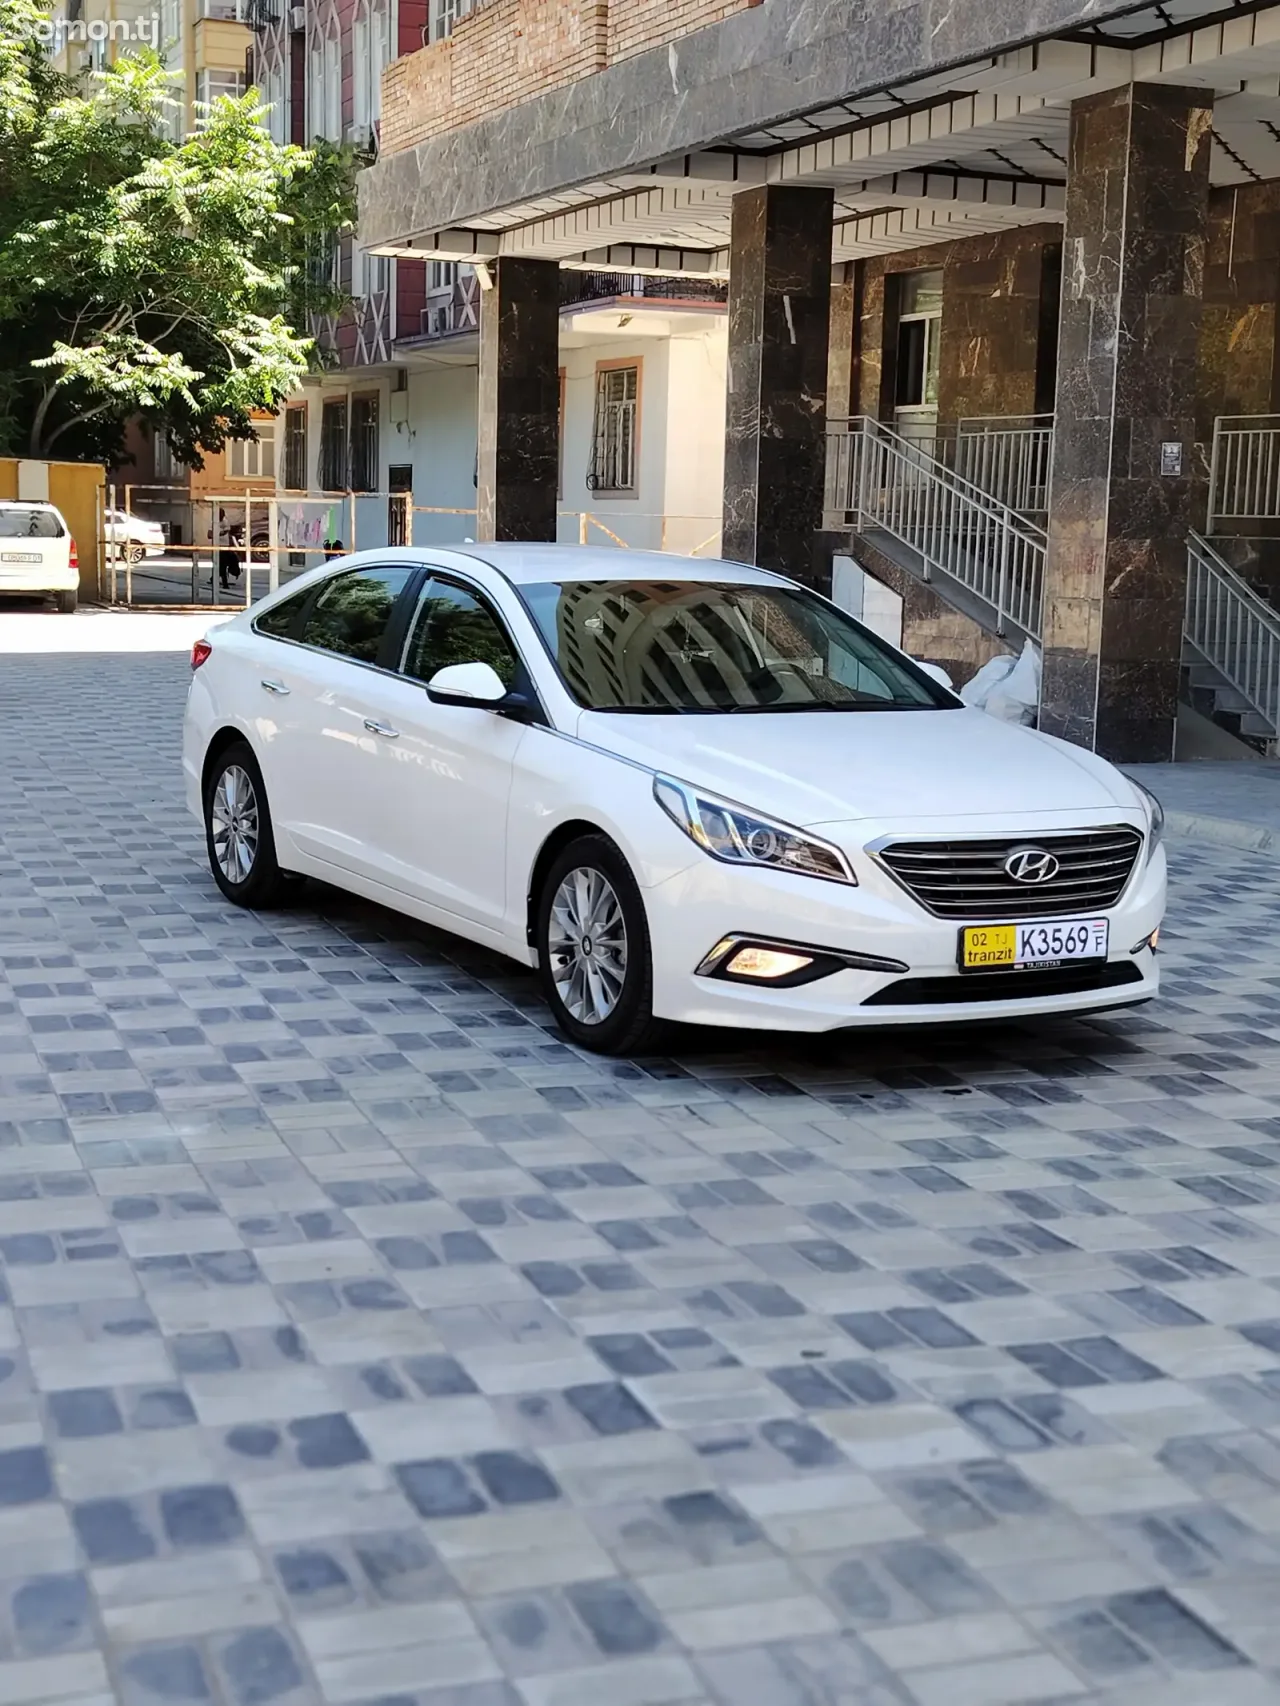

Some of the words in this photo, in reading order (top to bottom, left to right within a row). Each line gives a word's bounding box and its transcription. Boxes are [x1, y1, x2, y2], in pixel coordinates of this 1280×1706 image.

[971, 933, 987, 946] 02
[994, 933, 1008, 945] TJ
[1020, 926, 1089, 958] K3569
[968, 947, 1012, 962] tranzit
